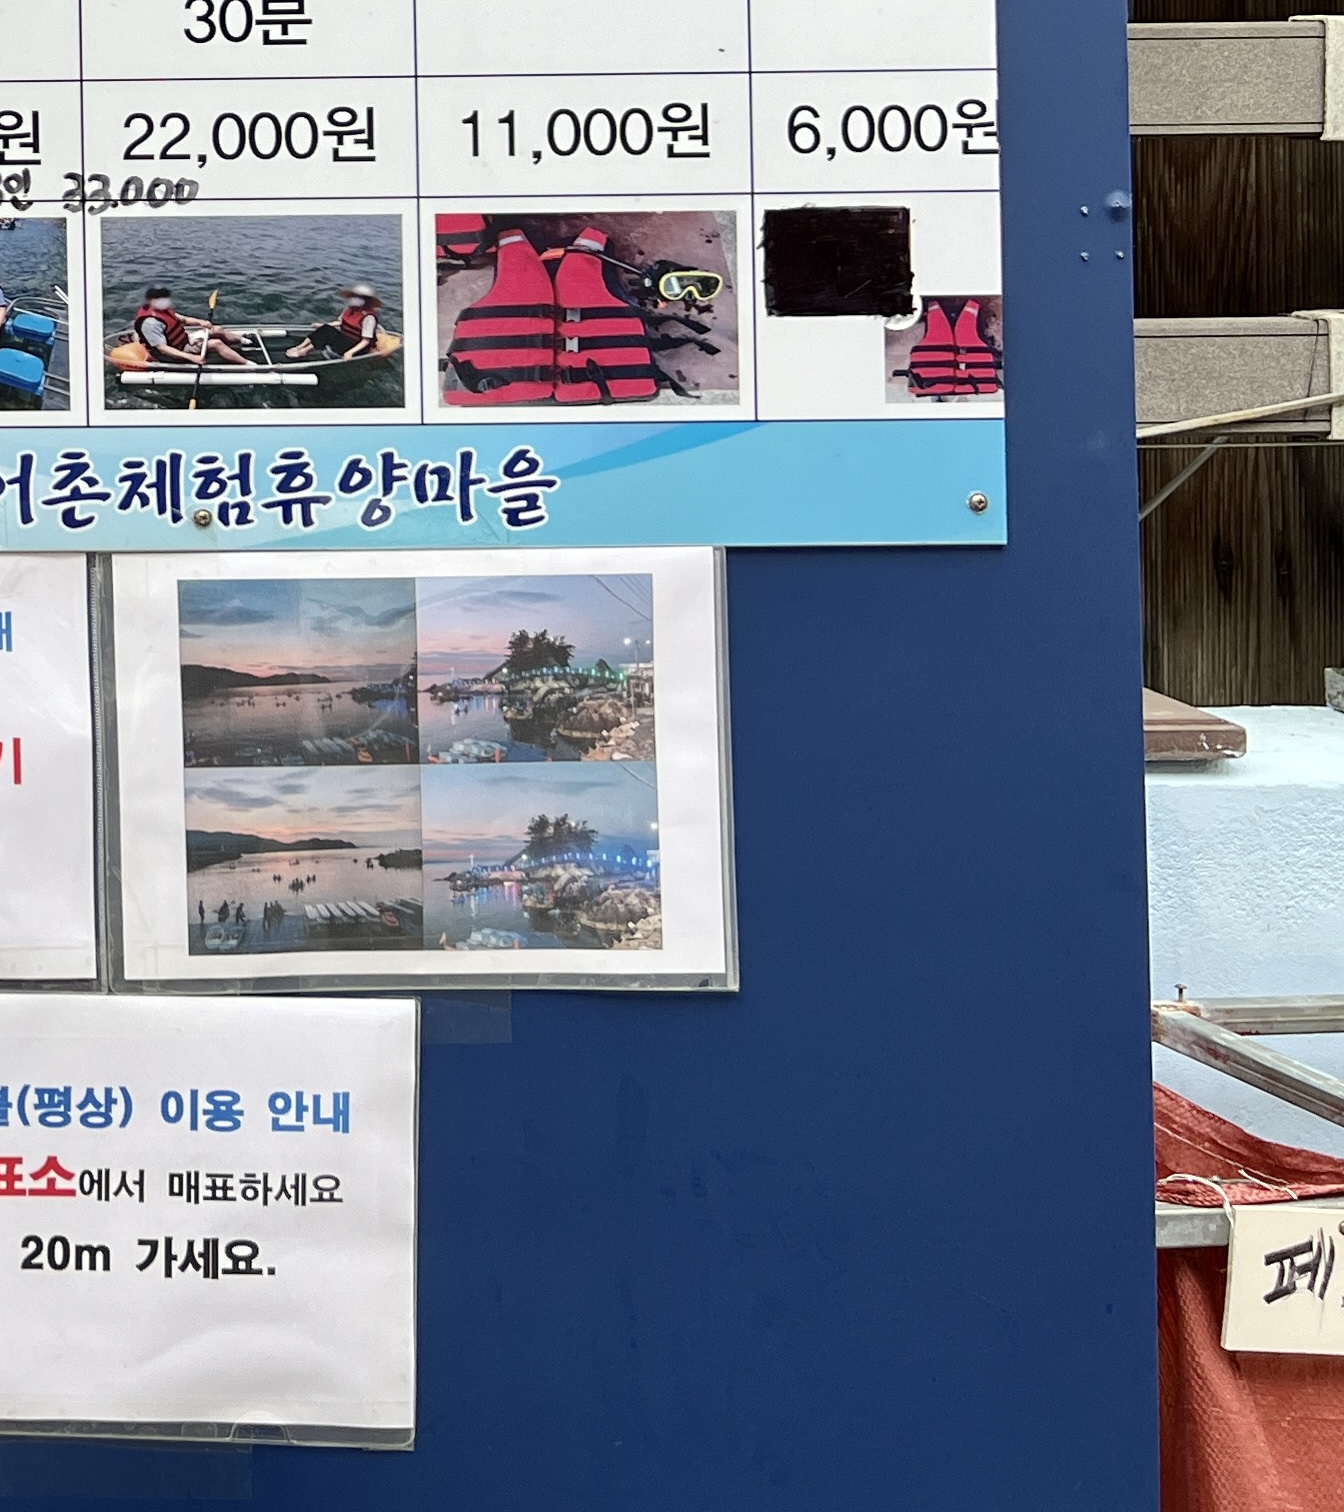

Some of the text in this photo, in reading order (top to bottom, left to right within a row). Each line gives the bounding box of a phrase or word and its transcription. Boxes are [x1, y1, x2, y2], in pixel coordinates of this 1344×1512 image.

[122, 106, 377, 167] 22,000원
[461, 102, 712, 164] 11,000원
[161, 1089, 244, 1132] 이용
[268, 1091, 350, 1134] 안내
[169, 1171, 343, 1206] 매표하세요
[21, 1235, 275, 1280] 20m 가세요.
